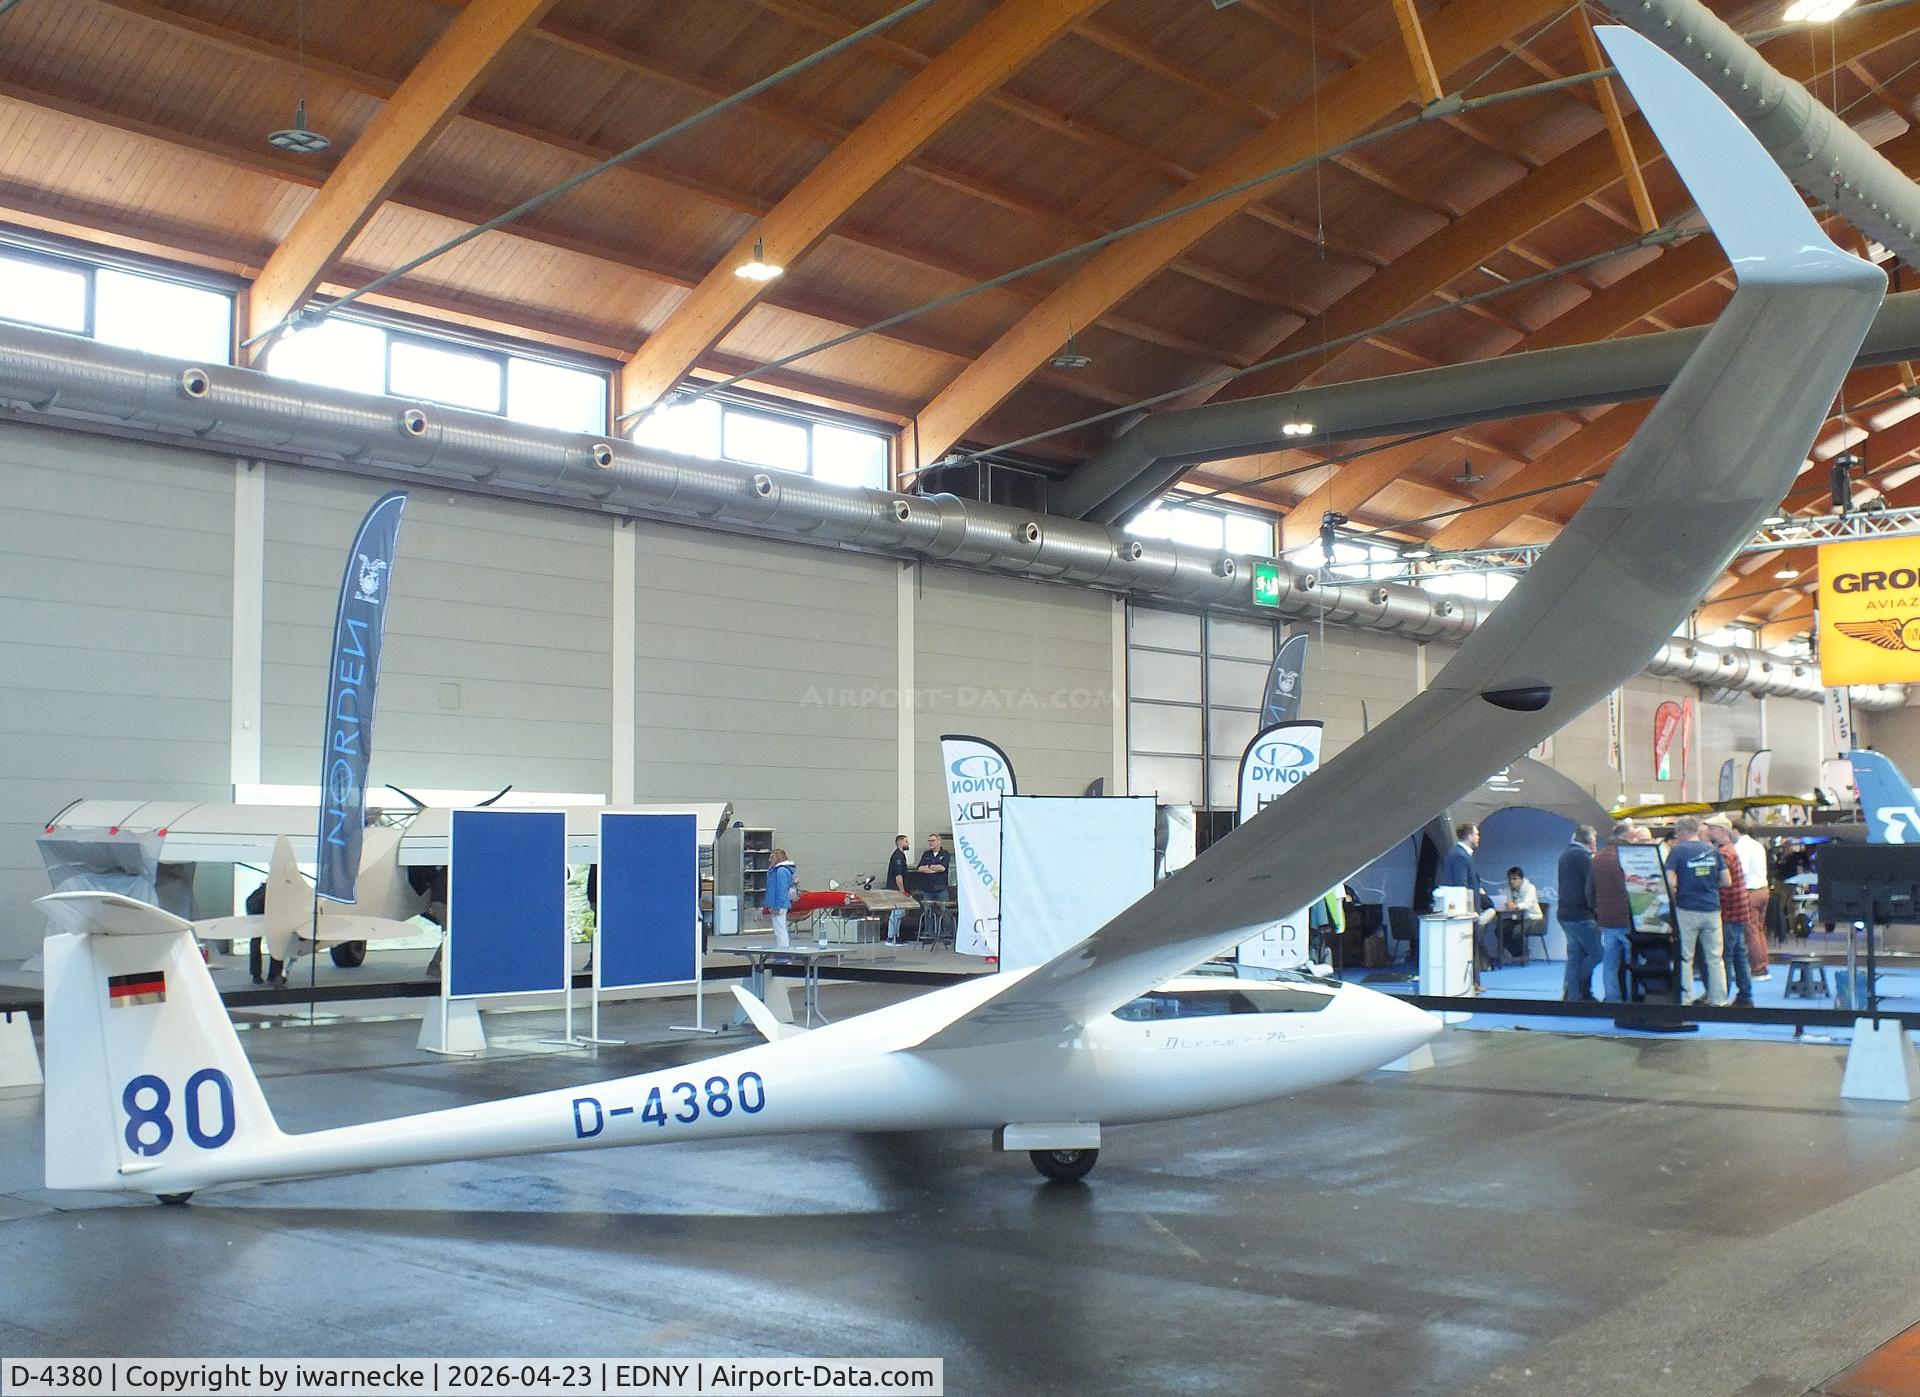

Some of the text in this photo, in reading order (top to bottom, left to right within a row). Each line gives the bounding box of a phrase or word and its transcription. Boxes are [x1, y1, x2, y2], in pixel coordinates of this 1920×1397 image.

[1833, 567, 1920, 594] GRO
[327, 618, 368, 847] NORDEN
[122, 1068, 236, 1157] 80
[572, 1071, 765, 1139] D-4380
